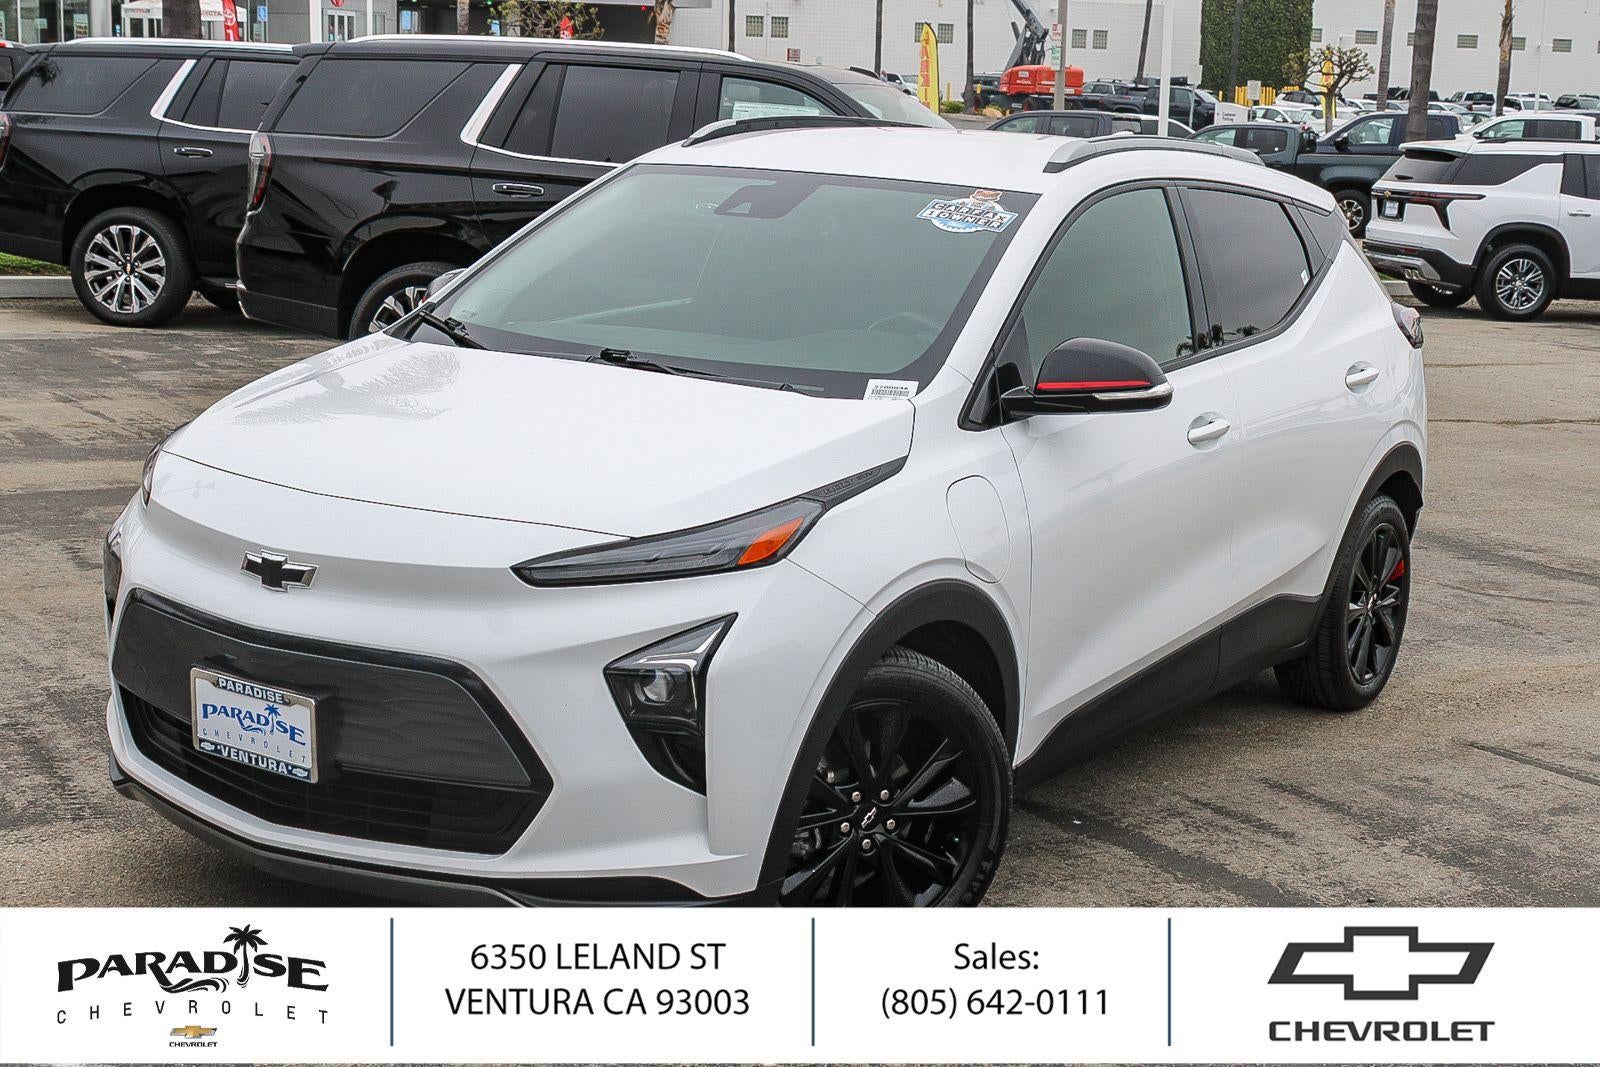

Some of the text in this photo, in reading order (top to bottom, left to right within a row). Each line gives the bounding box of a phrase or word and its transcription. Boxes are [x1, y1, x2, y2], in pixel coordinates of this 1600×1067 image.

[934, 202, 1007, 222] CARFAX
[218, 677, 284, 703] PARADISE
[202, 703, 306, 746] PARADISE
[203, 728, 306, 763] CHEVROLET
[220, 746, 288, 775] VENTURA
